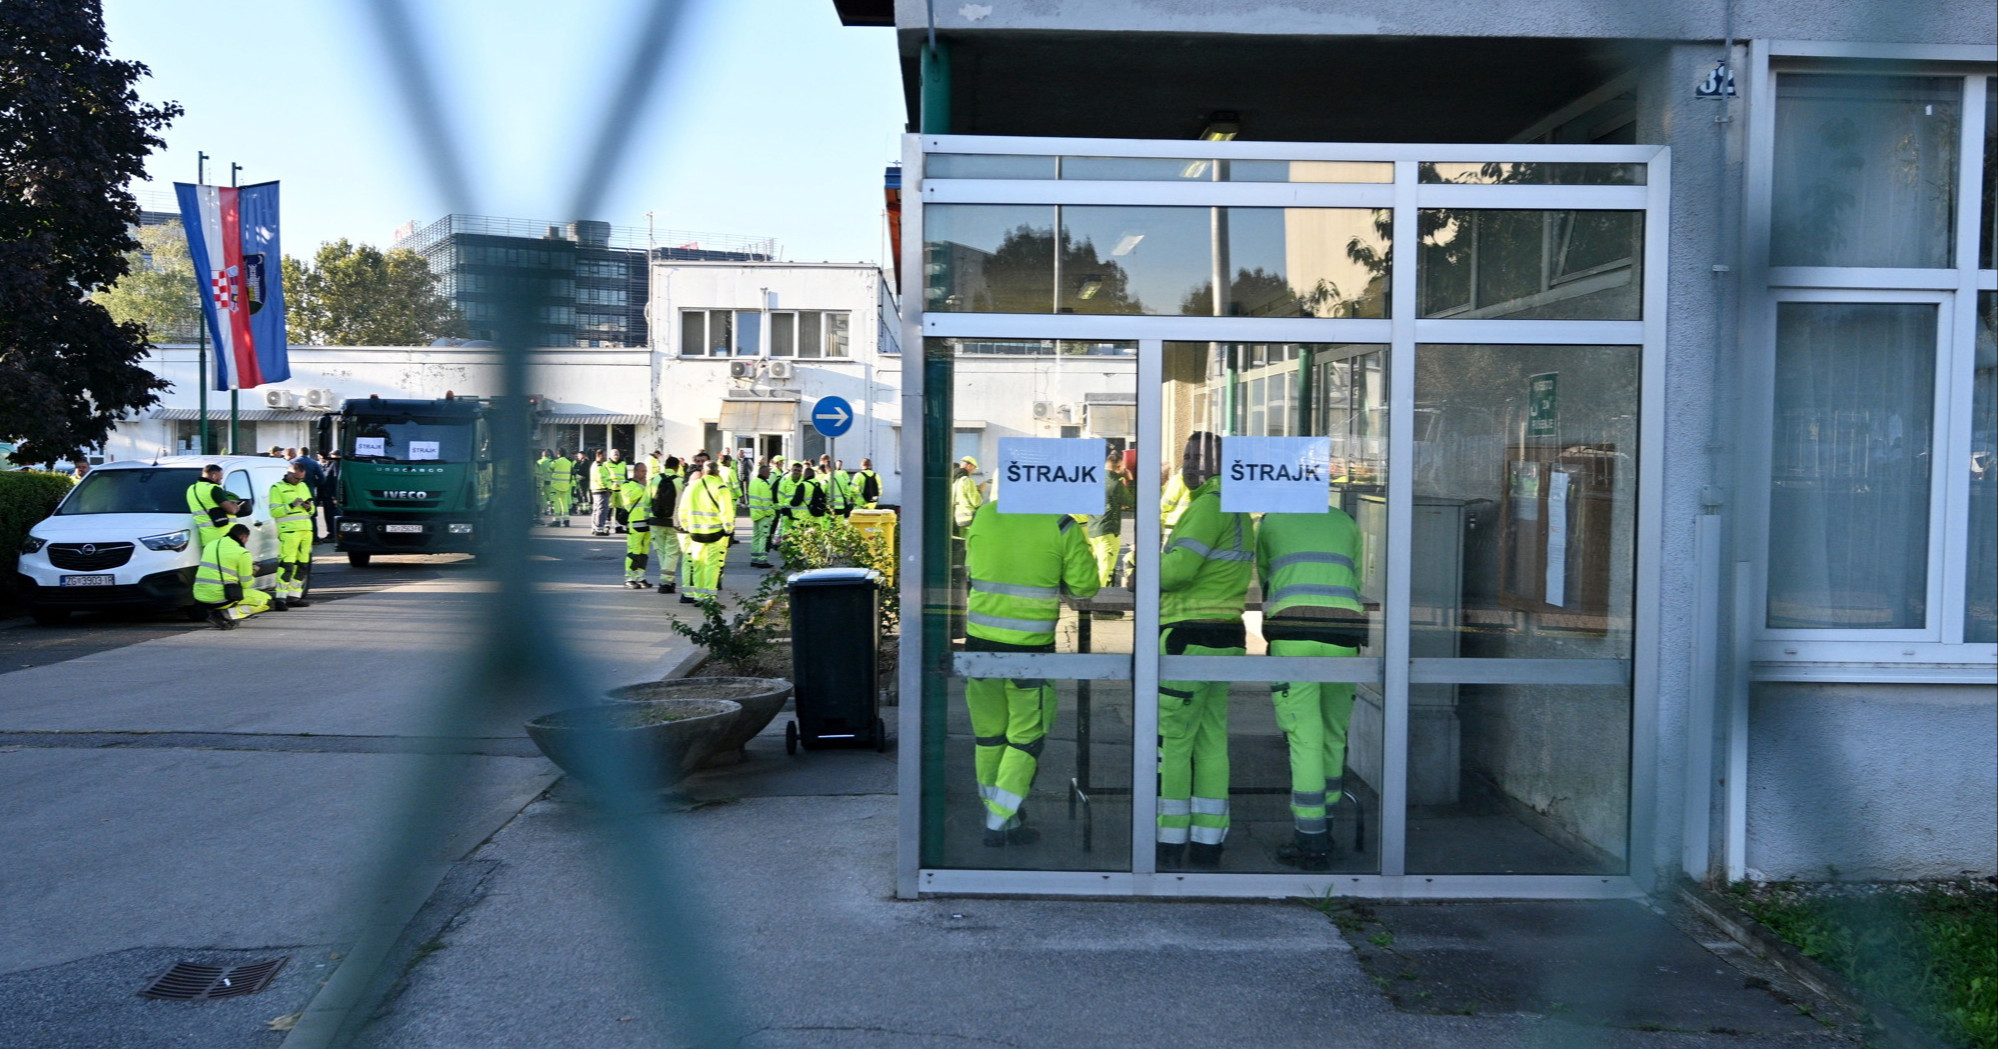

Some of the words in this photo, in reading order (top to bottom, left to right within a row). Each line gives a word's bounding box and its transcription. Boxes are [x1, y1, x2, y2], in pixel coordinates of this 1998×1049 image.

[1007, 461, 1097, 483] ŠTRAJK
[1231, 459, 1321, 482] ŠTRAJK
[383, 491, 427, 499] IVECO
